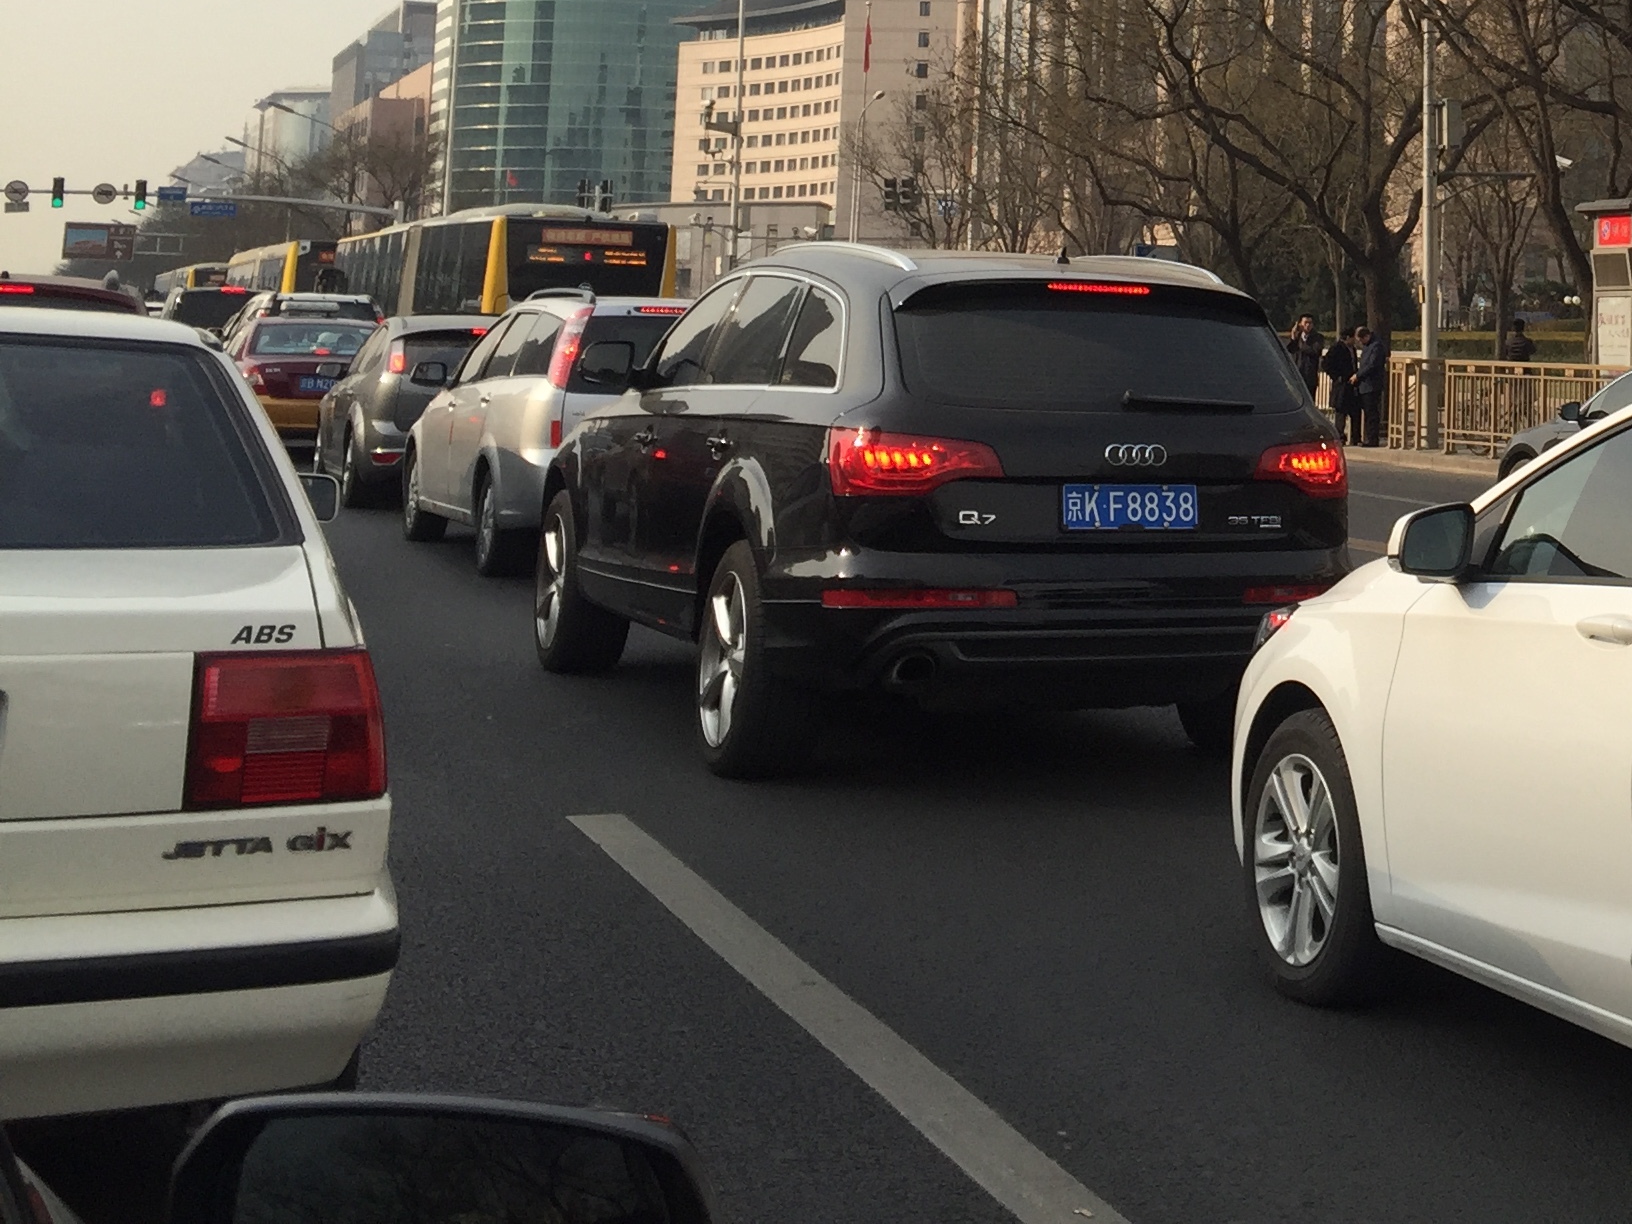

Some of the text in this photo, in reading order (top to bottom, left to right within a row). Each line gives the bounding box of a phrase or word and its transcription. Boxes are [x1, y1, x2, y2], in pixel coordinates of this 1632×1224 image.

[958, 510, 997, 525] Q7
[231, 624, 296, 645] ABS
[161, 836, 273, 860] JETTA
